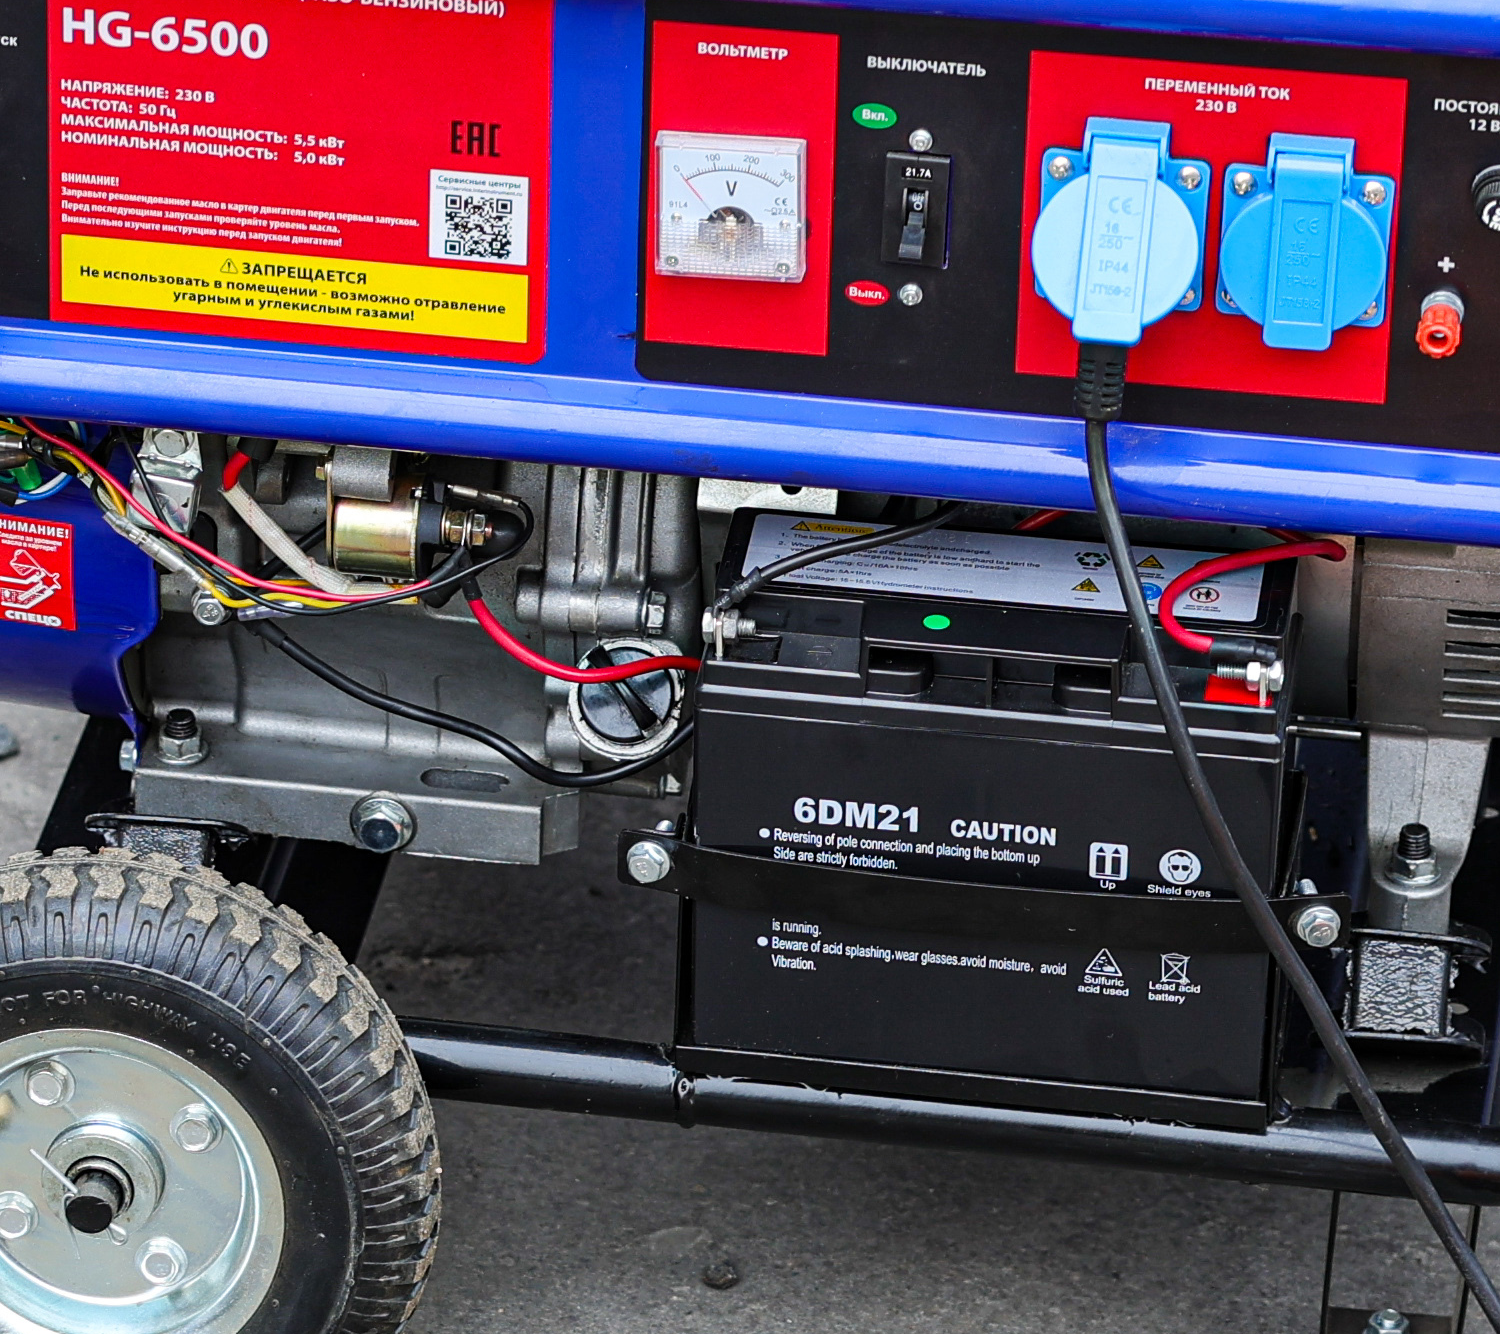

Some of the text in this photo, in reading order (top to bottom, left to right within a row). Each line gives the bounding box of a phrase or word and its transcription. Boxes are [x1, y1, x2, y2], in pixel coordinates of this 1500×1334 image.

[61, 6, 270, 60] HG-6500
[697, 42, 789, 61] ВОЛЬТМЕТР
[867, 55, 987, 77] ВЫКЛЮЧАТЕЛЬ
[60, 78, 215, 103] НАПРЯЖЕНИЕ: 230 В
[1144, 77, 1290, 101] ПЕРЕМЕННЫЙ ТОК
[60, 96, 177, 119] ЧАСТОТА: 50 Гц
[861, 108, 889, 122] Вкл.
[1195, 99, 1237, 114] 230 В
[60, 113, 345, 150] МАКСИМАЛЬНАЯ МОЩНОСТЬ: 5,5 кВт
[1468, 119, 1487, 132] 12
[60, 131, 345, 167] НОМИНАЛЬНАЯ МОЩНОСТЬ: 5,0 кВт
[705, 153, 721, 162] 100
[743, 154, 760, 165] 200
[61, 172, 120, 187] ВНИМАНИЕ!
[780, 169, 796, 183] 300
[905, 167, 932, 178] 21.7A
[438, 175, 522, 190] Сервисные центры
[725, 180, 738, 197] V
[61, 186, 107, 199] Заправьте
[108, 192, 190, 207] рекомендованное
[192, 200, 219, 209] масло
[228, 203, 259, 214] картер
[260, 205, 306, 218] двигателя
[307, 209, 335, 221] перед
[336, 212, 374, 224] первым
[375, 215, 420, 227] запуском.
[61, 200, 90, 212] Перед
[91, 204, 163, 218] последующими
[164, 211, 212, 223] запусками
[214, 214, 268, 227] проверяйте
[269, 219, 307, 231] уровень
[61, 214, 343, 247] Внимательно изучите инструкцию перед запуском двигателя!
[1097, 237, 1123, 249] 250
[242, 262, 367, 285] ЗАПРЕЩАЕТСЯ
[1098, 259, 1129, 273] IP44
[79, 265, 507, 315] Не использовать в помещении возможно отравление
[848, 286, 885, 301] Выкл.
[173, 291, 415, 322] угарным и углекислым газами!
[794, 796, 1058, 845] 6DM21 CAUTION
[774, 828, 1041, 866] Reversing of pole connection and placing the bottom up
[773, 847, 898, 870] Side are strictly forbidden.
[1100, 879, 1116, 892] Up
[1147, 883, 1211, 899] Shield eyes
[772, 918, 822, 937] is running.
[771, 937, 808, 954] Beware
[811, 940, 821, 954] of
[823, 942, 842, 956] acid
[1040, 961, 1067, 976] avoid
[771, 954, 817, 971] Vibration.
[1084, 974, 1125, 987] Sulfuric
[1149, 981, 1201, 994] Lead acid
[1077, 983, 1130, 997] acid used
[1148, 992, 1186, 1005] battery
[42, 989, 88, 1007] FOR
[102, 990, 197, 1032] HIGHWAY
[206, 1032, 252, 1069] USE
